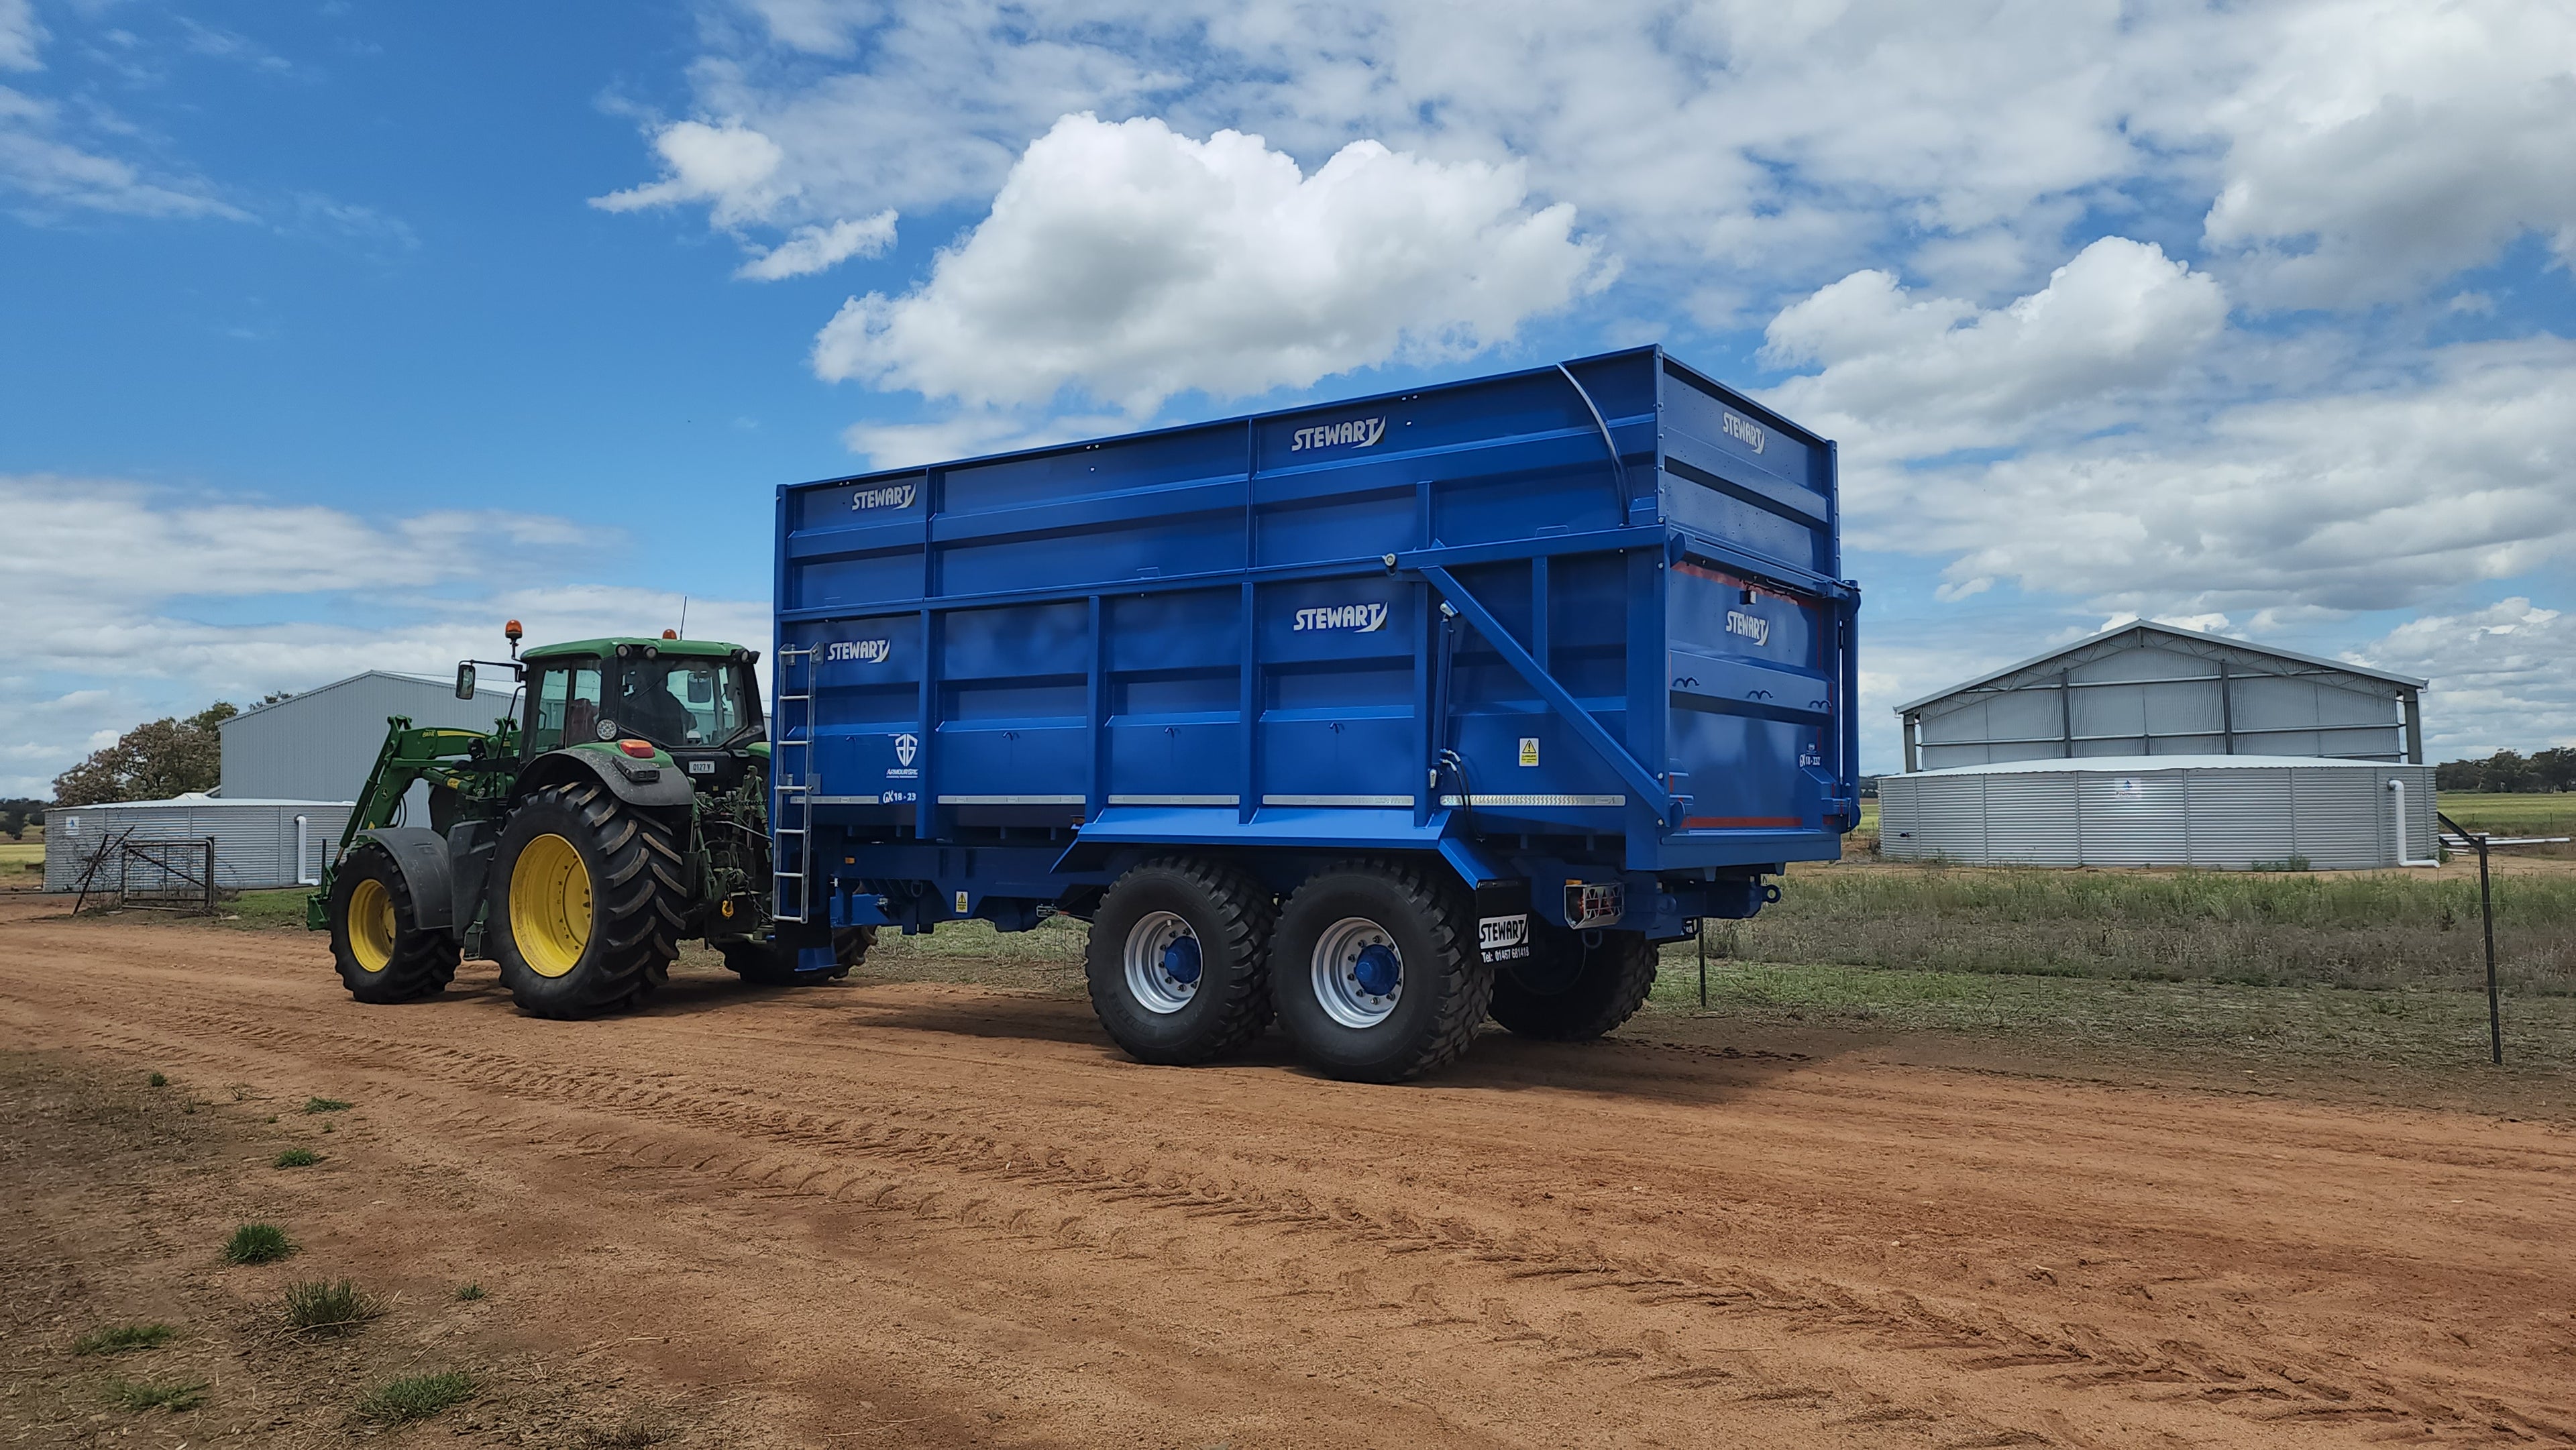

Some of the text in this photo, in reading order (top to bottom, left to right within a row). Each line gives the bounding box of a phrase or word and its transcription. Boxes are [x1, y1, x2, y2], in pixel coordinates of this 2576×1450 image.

[1291, 416, 1386, 451] STEWART
[1723, 412, 1765, 455] STEWART
[852, 484, 916, 510] STEWART
[1293, 602, 1388, 633] STEWART
[1726, 610, 1769, 647] STEWART
[827, 639, 890, 663] STEWART
[1480, 917, 1528, 945] STEWART
[1481, 951, 1494, 963] Tel:
